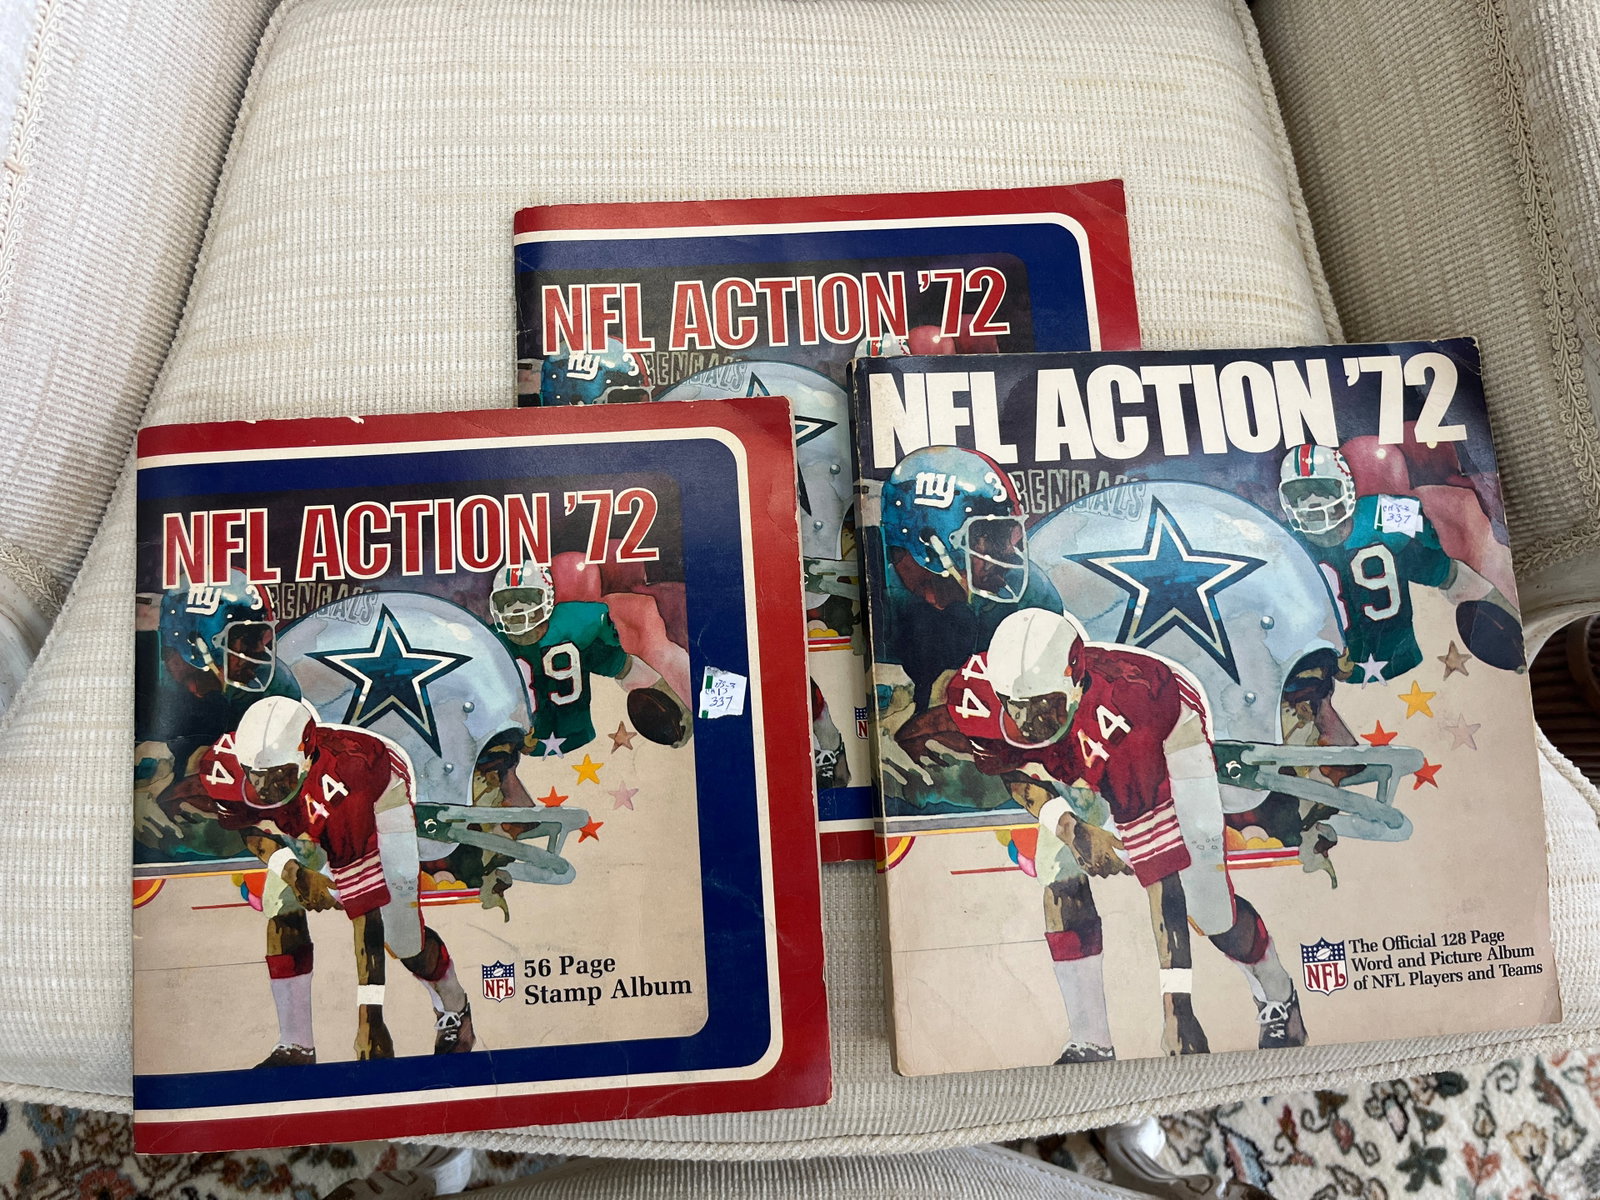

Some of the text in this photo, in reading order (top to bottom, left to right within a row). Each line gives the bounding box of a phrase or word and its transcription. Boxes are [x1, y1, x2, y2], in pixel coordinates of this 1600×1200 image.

[541, 282, 656, 356] NFL
[669, 270, 909, 350] ACTION
[868, 371, 1018, 469] NFL
[1034, 358, 1340, 463] ACTION
[162, 507, 281, 590] NFL
[295, 492, 552, 582] ACTION
[1348, 929, 1505, 954] The Official 128 Page
[524, 955, 616, 979] 56 Page
[1351, 943, 1535, 972] Word and Picture Album
[484, 978, 514, 999] NFL
[524, 976, 693, 1006] Stamp Album
[1304, 962, 1346, 993] NFL
[1353, 962, 1543, 991] of NFL Players and Teams
